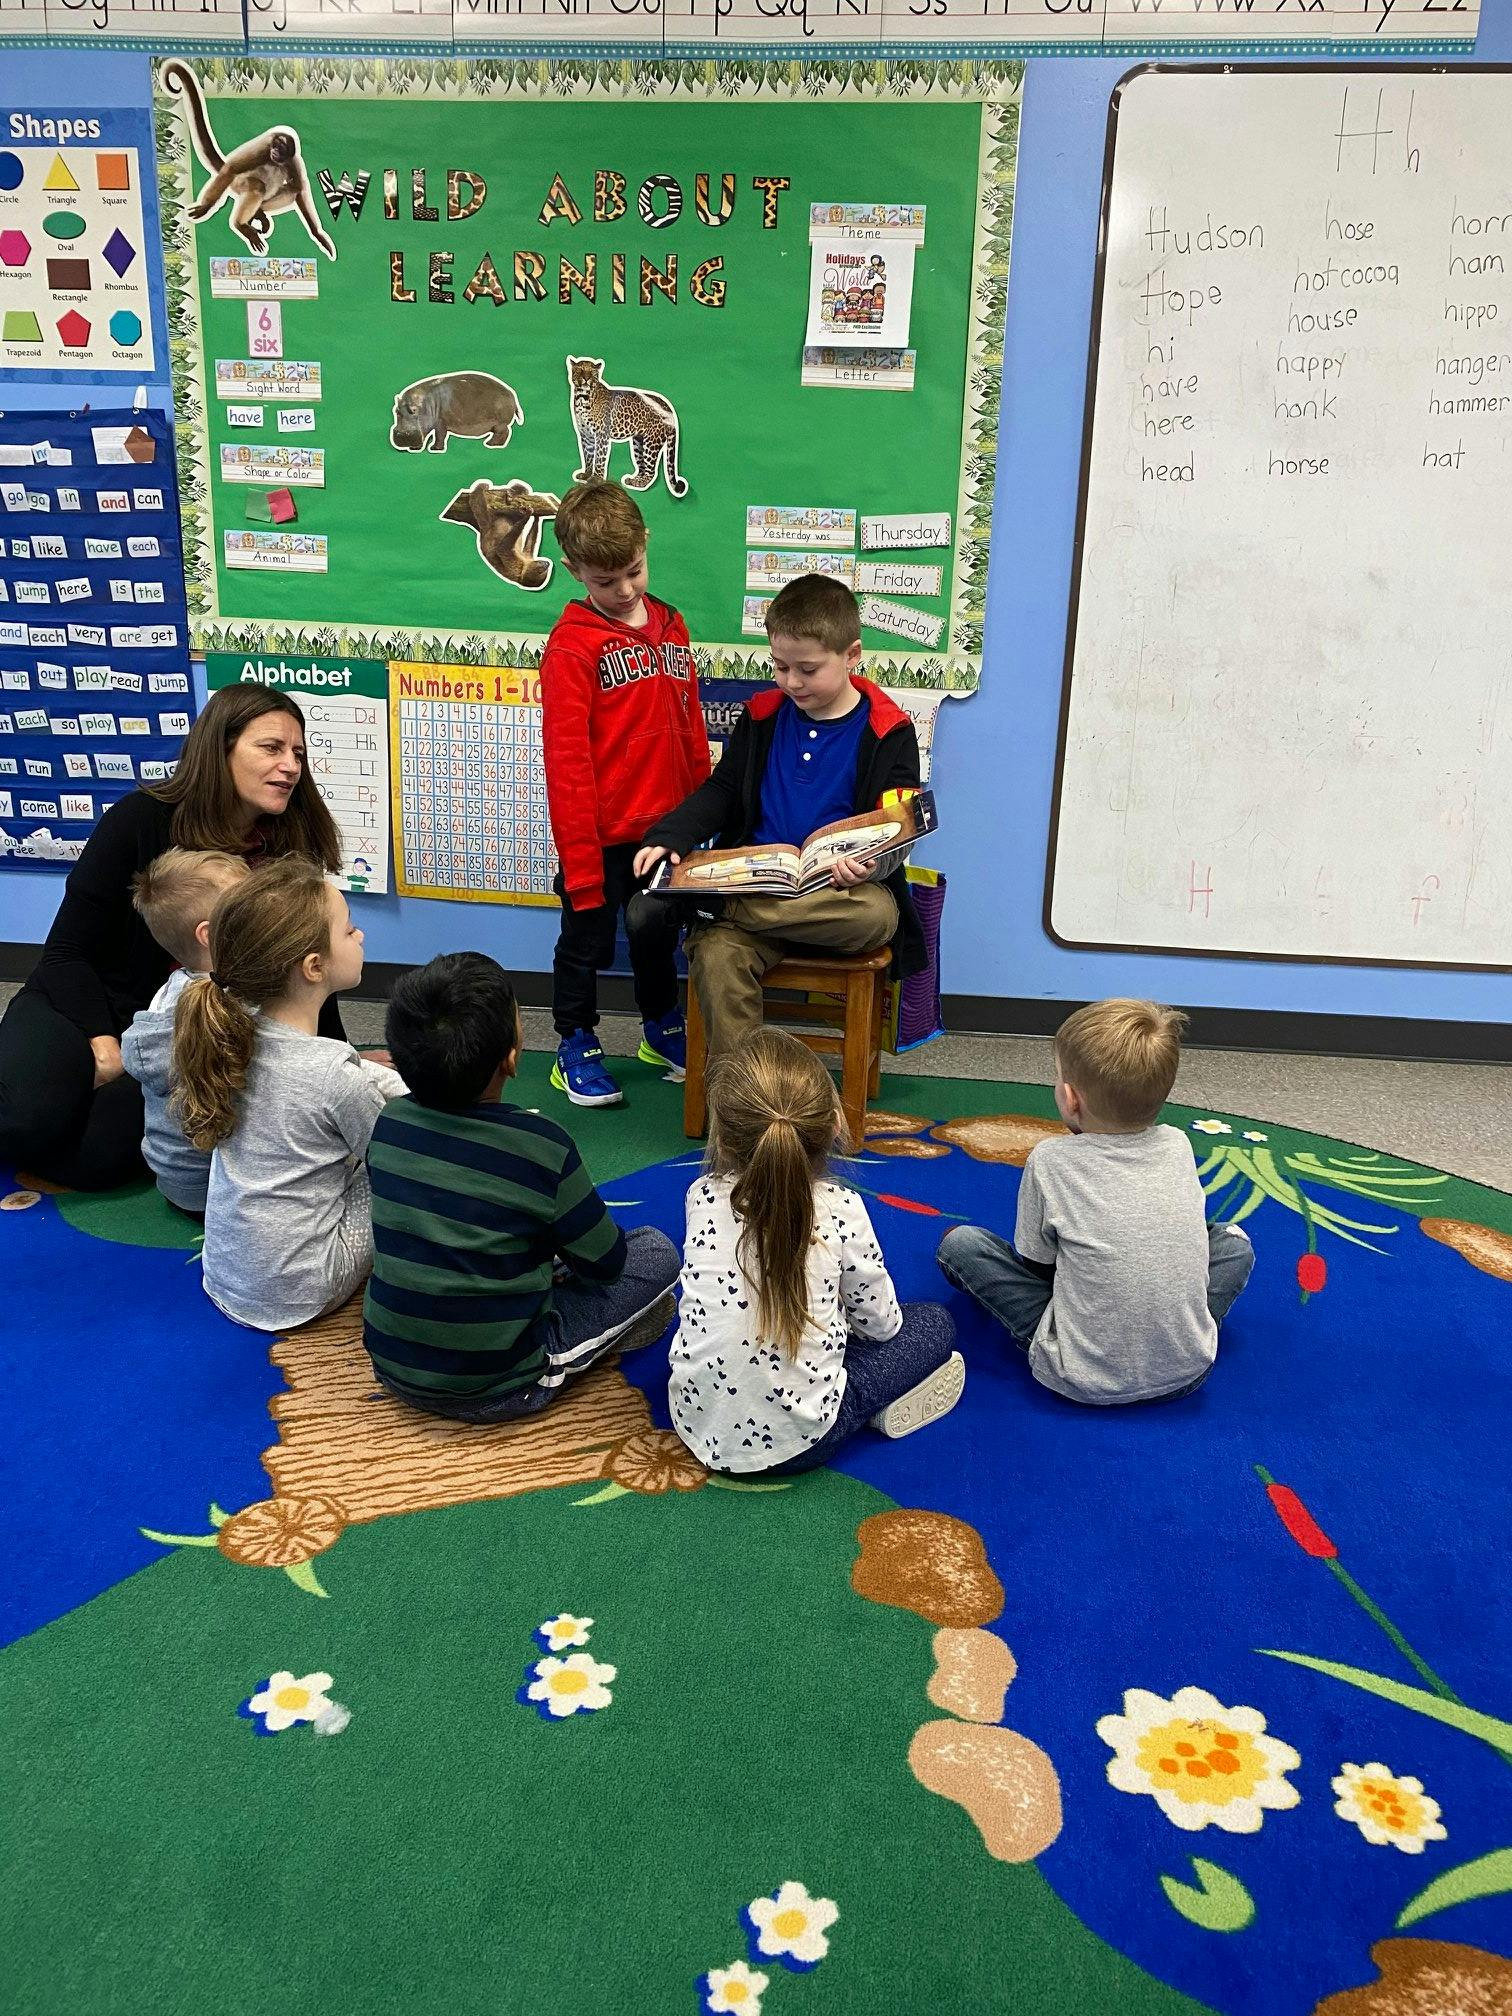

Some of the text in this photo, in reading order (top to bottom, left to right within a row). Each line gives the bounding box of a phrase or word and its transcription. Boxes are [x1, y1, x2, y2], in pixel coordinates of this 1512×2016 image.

[10, 113, 101, 144] Shapes
[47, 196, 77, 205] Triangle
[102, 197, 128, 206] Square
[316, 168, 791, 229] WILD ABOUT
[1325, 198, 1375, 240] hose
[839, 225, 881, 239] Theme
[1145, 206, 1264, 254] Hudson
[57, 243, 75, 251] Oval
[826, 254, 866, 265] Holidays
[1448, 244, 1504, 276] ham
[0, 271, 32, 279] Hexagon
[389, 251, 727, 308] LEARNING
[104, 283, 139, 291] Rhombus
[240, 280, 287, 291] Number
[52, 293, 88, 302] Rectangle
[1140, 270, 1222, 326] Hope
[258, 308, 272, 331] 6
[1288, 302, 1358, 333] house
[1444, 298, 1497, 329] hippo
[254, 334, 278, 352] six
[1147, 330, 1174, 363] hi
[6, 348, 42, 358] Trapezoid
[58, 350, 94, 359] Pentagon
[112, 350, 143, 360] Octagon
[1276, 340, 1347, 381] happy
[1435, 346, 1511, 385] hanger
[835, 369, 879, 381] Letter
[246, 382, 300, 397] Sight Word
[1141, 373, 1198, 402] have
[1428, 389, 1511, 414] hammer
[229, 409, 262, 423] have
[280, 412, 312, 425] here
[1144, 410, 1194, 437] here
[1423, 438, 1465, 470] hat
[1142, 450, 1194, 482] head
[1268, 450, 1329, 475] horse
[244, 465, 271, 479] Shape
[286, 468, 312, 479] Color
[8, 492, 24, 505] go
[30, 495, 46, 507] go
[64, 490, 78, 502] in
[101, 495, 126, 509] and
[137, 494, 161, 504] can
[762, 527, 831, 542] Yesterday was
[872, 523, 941, 541] Thursday
[13, 543, 28, 554] go
[38, 541, 63, 555] like
[87, 540, 119, 553] have
[132, 540, 157, 552] each
[253, 552, 291, 563] Animal
[873, 568, 923, 591] Friday
[17, 583, 47, 600] jump
[58, 583, 90, 596] here
[115, 581, 127, 594] is
[138, 586, 162, 599] the
[868, 604, 935, 642] Saturday
[0, 625, 22, 638] and
[31, 630, 65, 642] each
[75, 628, 103, 643] very
[120, 633, 142, 643] are
[151, 630, 173, 643] get
[13, 674, 27, 687] up
[40, 669, 63, 681] out
[75, 667, 108, 687] play
[240, 660, 352, 687] Alphabet
[110, 675, 140, 689] read
[155, 676, 186, 691] jump
[400, 673, 484, 700] Numbers
[18, 712, 47, 726] each
[309, 705, 377, 724] Cc Dd
[422, 703, 427, 717] 2
[438, 704, 444, 718] 3
[454, 705, 460, 719] 4
[470, 705, 476, 719] 5
[487, 707, 492, 721] 6
[503, 708, 509, 721] 7
[519, 709, 525, 722] 8
[61, 720, 76, 730] so
[85, 716, 112, 732] play
[123, 721, 147, 731] are
[170, 717, 186, 730] up
[404, 721, 413, 735] 11
[420, 723, 430, 737] 12
[436, 724, 446, 737] 13
[452, 725, 462, 738] 14
[468, 726, 479, 739] 15
[484, 727, 495, 740] 16
[500, 728, 511, 741] 17
[516, 729, 527, 742] 18
[309, 732, 377, 754] Gg Hh
[404, 741, 544, 762] 21 22 23 24 25 26 27 28 29
[28, 764, 49, 774] run
[70, 758, 88, 771] be
[98, 758, 129, 772] have
[312, 759, 332, 773] Kk
[404, 759, 544, 781] 31 32 33 34 35 36 37 38 39
[144, 767, 163, 777] we
[358, 786, 377, 808] Pp
[22, 802, 56, 813] come
[66, 799, 90, 812] like
[359, 811, 376, 827] Tt
[359, 838, 377, 853] Xx
